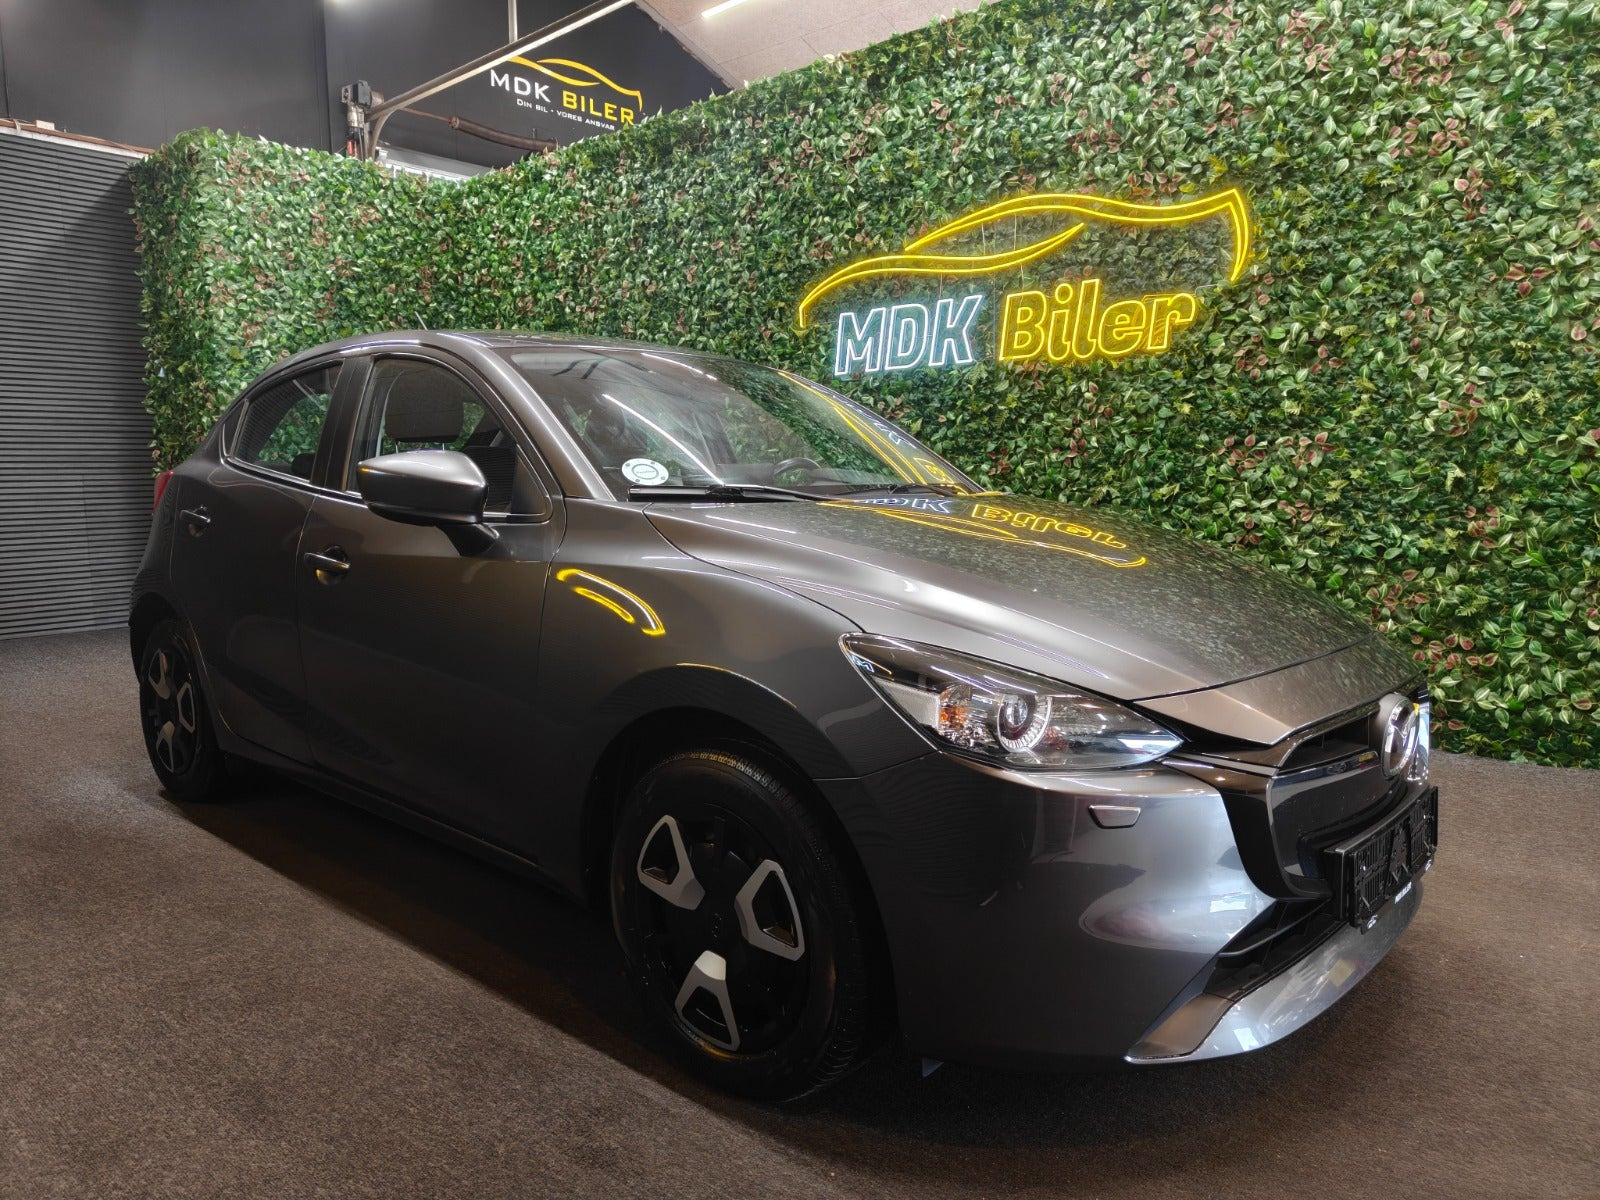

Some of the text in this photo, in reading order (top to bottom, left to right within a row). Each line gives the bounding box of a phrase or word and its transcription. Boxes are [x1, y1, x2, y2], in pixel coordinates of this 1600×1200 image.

[490, 69, 634, 126] MDK BILER
[535, 104, 549, 113] BIL
[556, 109, 583, 122] VORES
[834, 278, 1197, 376] MDK Biler
